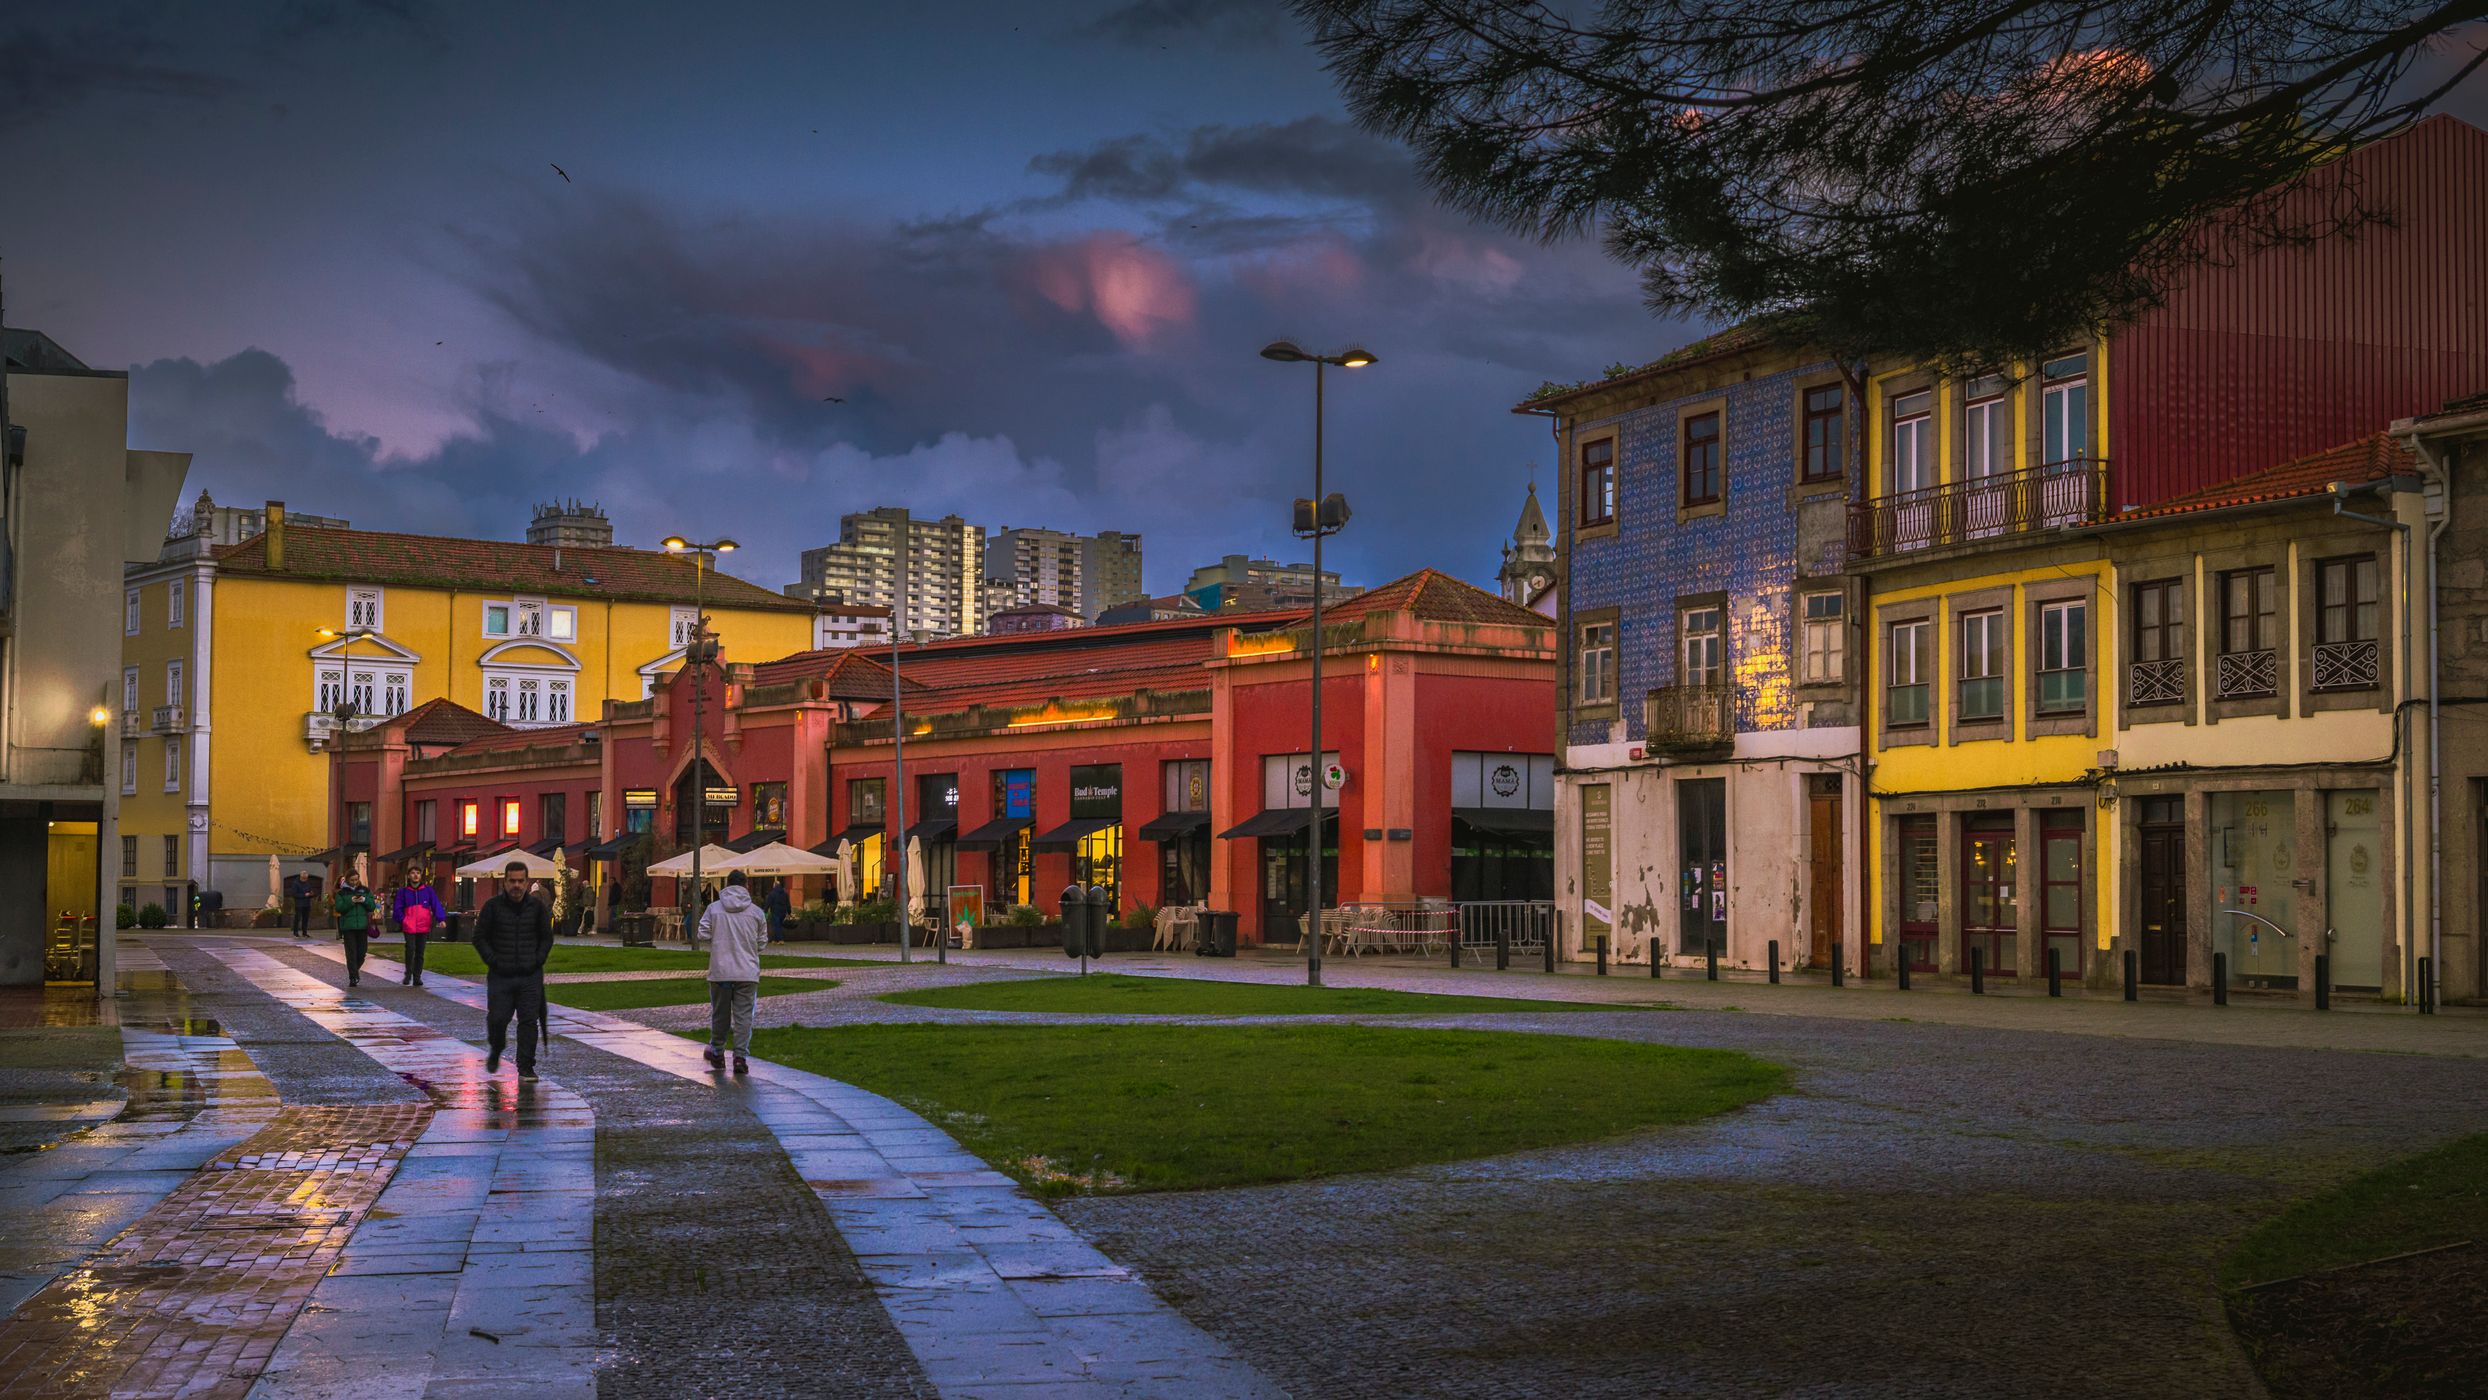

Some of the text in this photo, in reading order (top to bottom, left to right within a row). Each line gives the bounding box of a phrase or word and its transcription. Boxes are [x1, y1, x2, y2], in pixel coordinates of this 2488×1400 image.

[1074, 785, 1118, 798] Bud Temple
[2246, 800, 2268, 817] 266
[2345, 798, 2370, 816] 264
